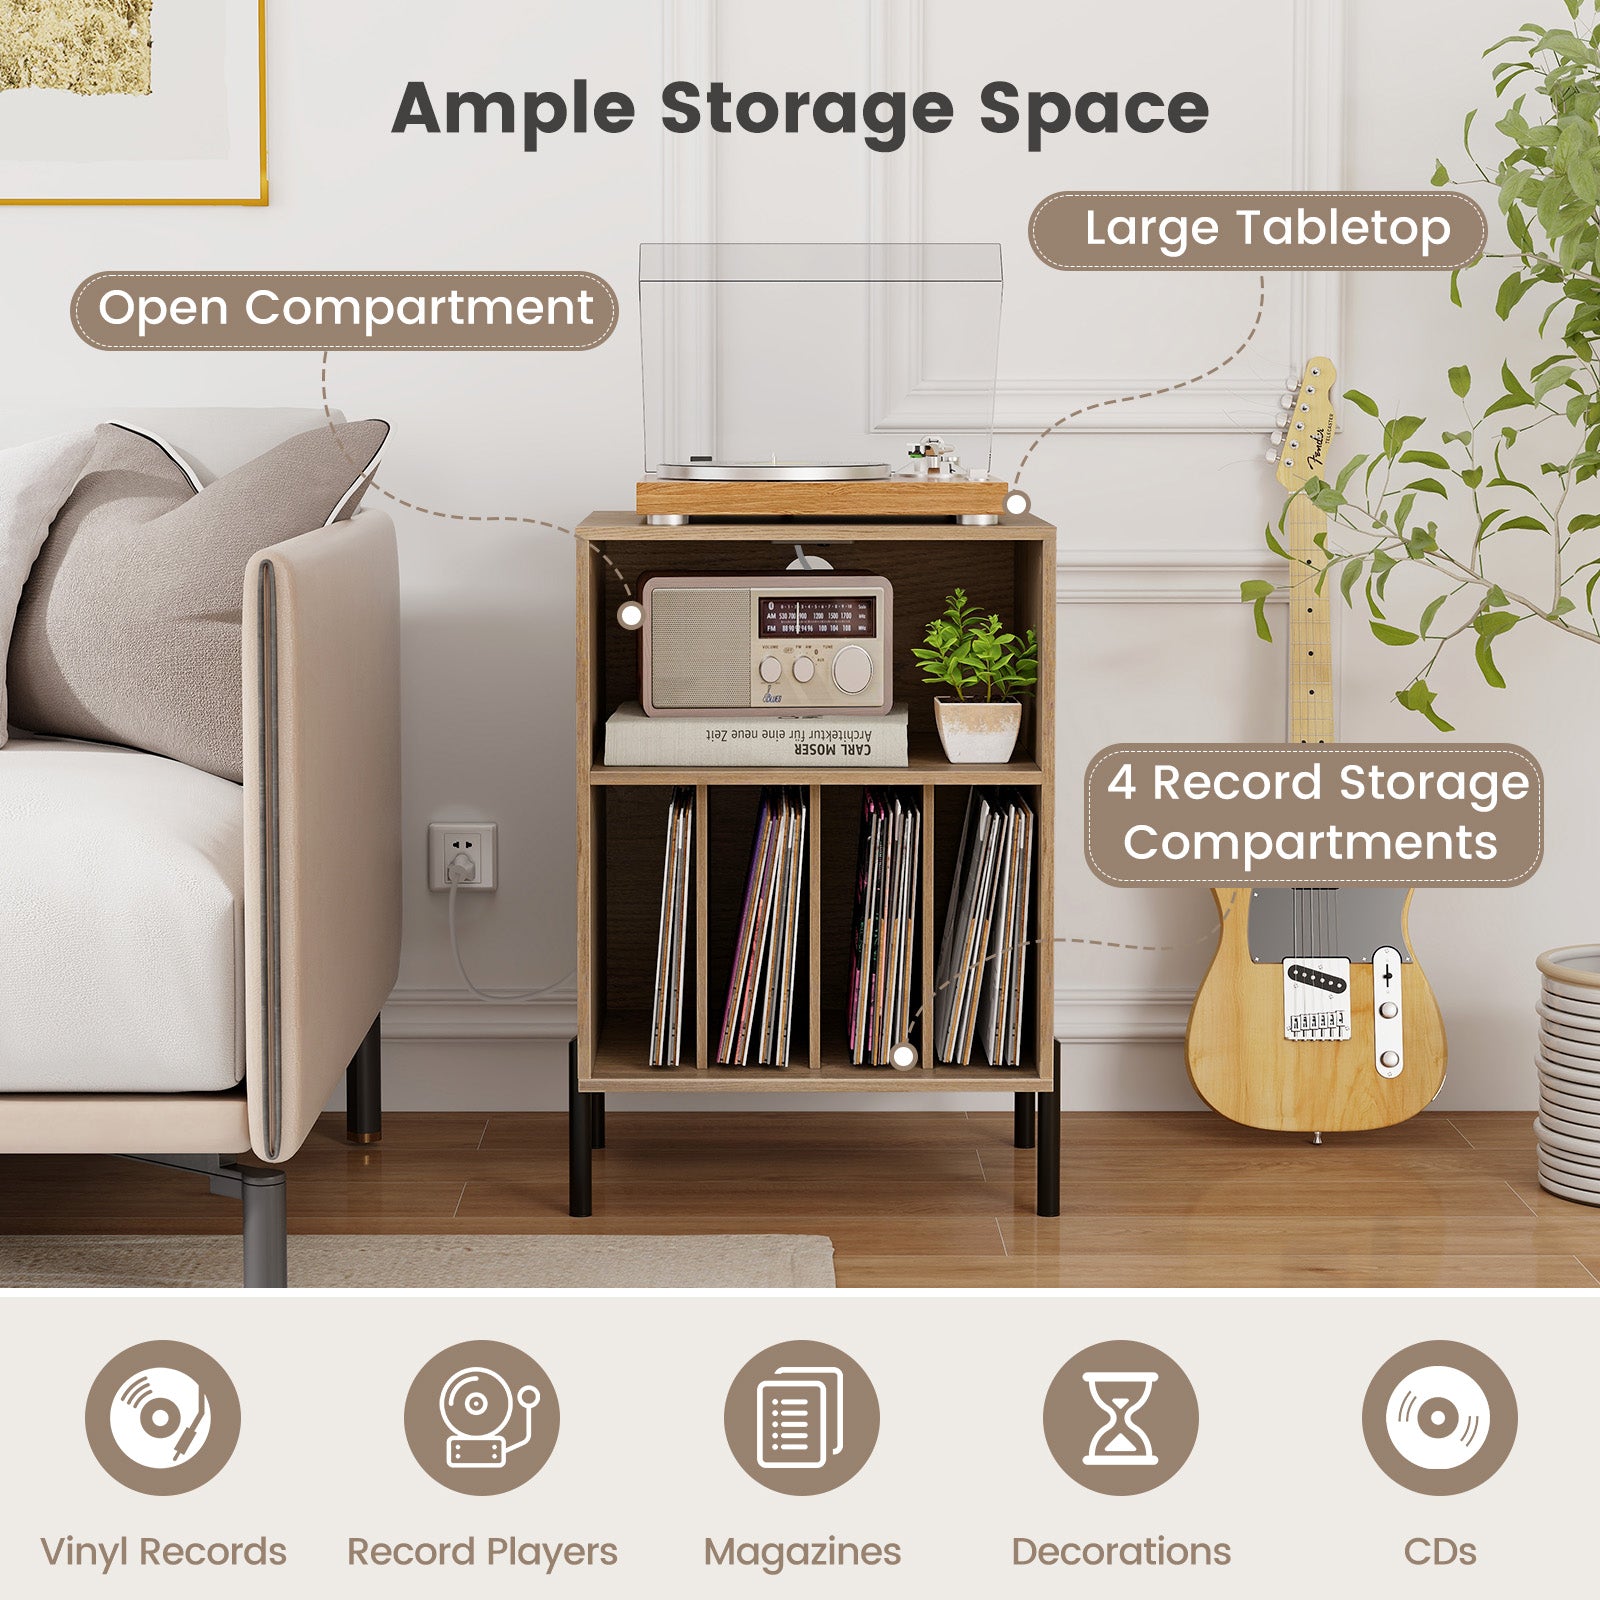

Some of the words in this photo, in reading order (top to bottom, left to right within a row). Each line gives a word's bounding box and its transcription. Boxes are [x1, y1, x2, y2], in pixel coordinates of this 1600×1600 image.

[1325, 413, 1334, 444] TELECASTER
[841, 612, 852, 620] 1700
[706, 730, 728, 742] Zeit
[731, 730, 758, 739] neue
[761, 730, 786, 741] eine
[789, 730, 806, 743] für
[808, 730, 872, 743] Architektur
[794, 743, 836, 756] MOSER
[840, 743, 872, 756] CARL
